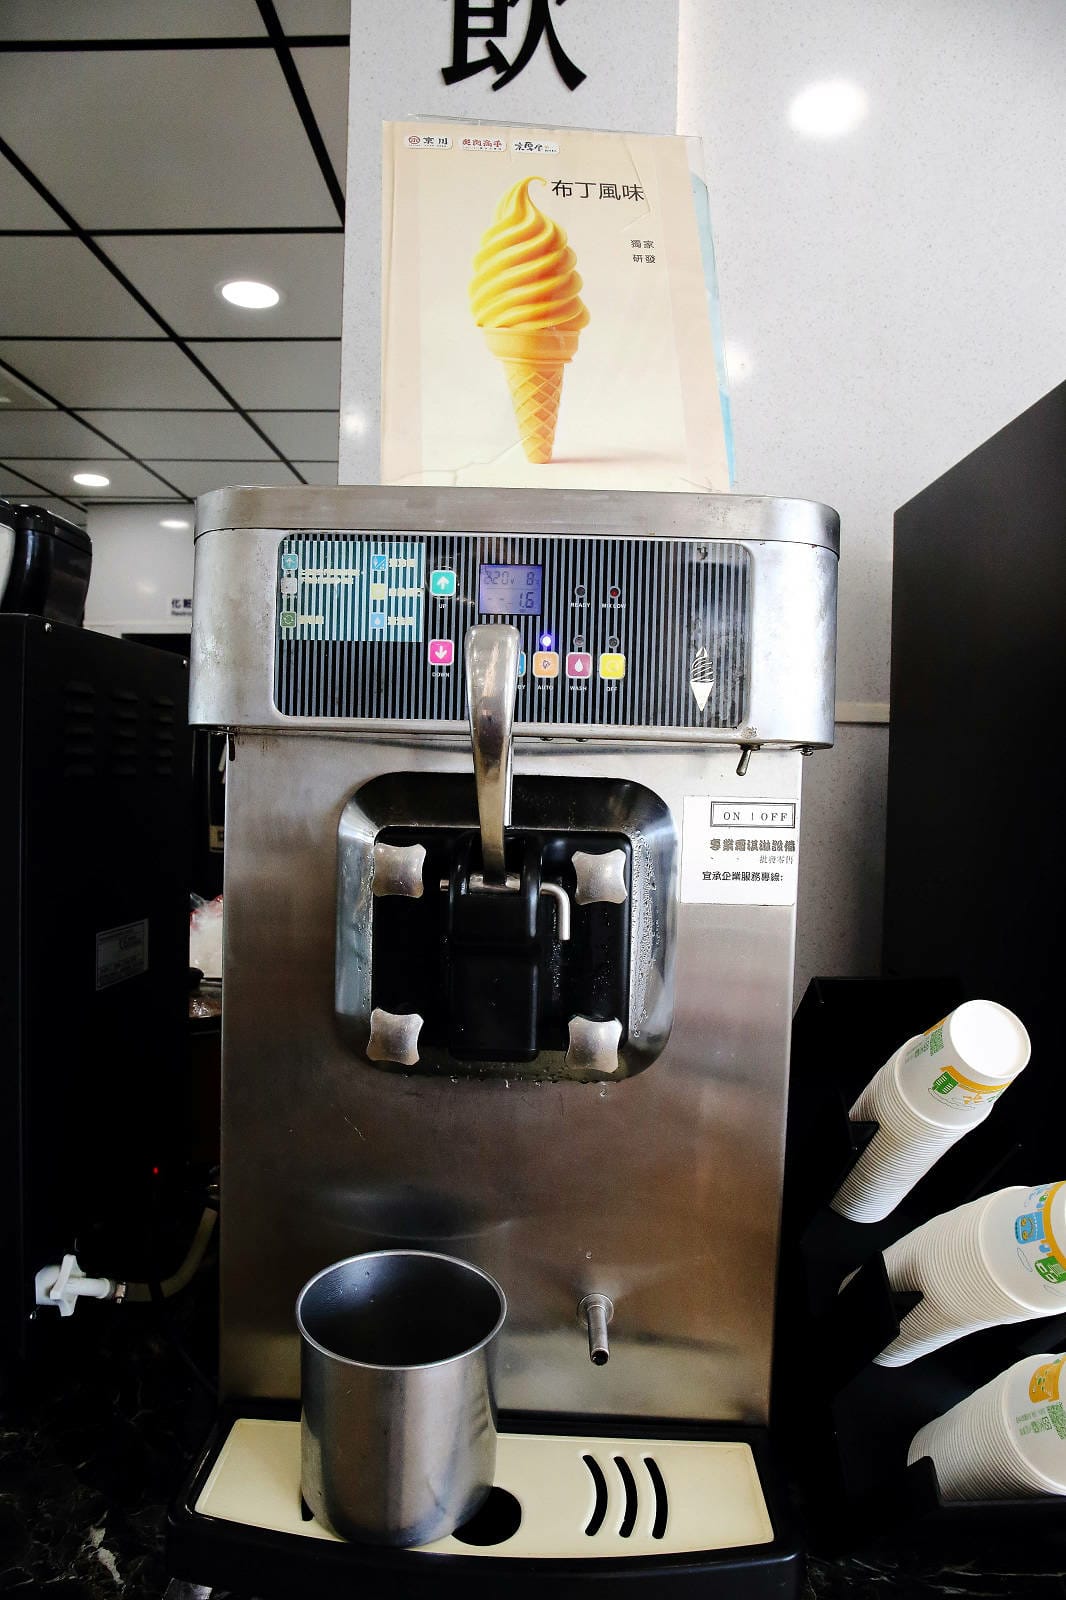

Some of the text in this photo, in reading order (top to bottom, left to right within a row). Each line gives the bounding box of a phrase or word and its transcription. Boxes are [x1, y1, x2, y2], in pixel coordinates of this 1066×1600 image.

[422, 136, 448, 145] 京川
[551, 179, 645, 201] 布丁風味
[630, 239, 655, 249] 獨家
[632, 254, 656, 264] 研發
[723, 811, 788, 822] ON OFF
